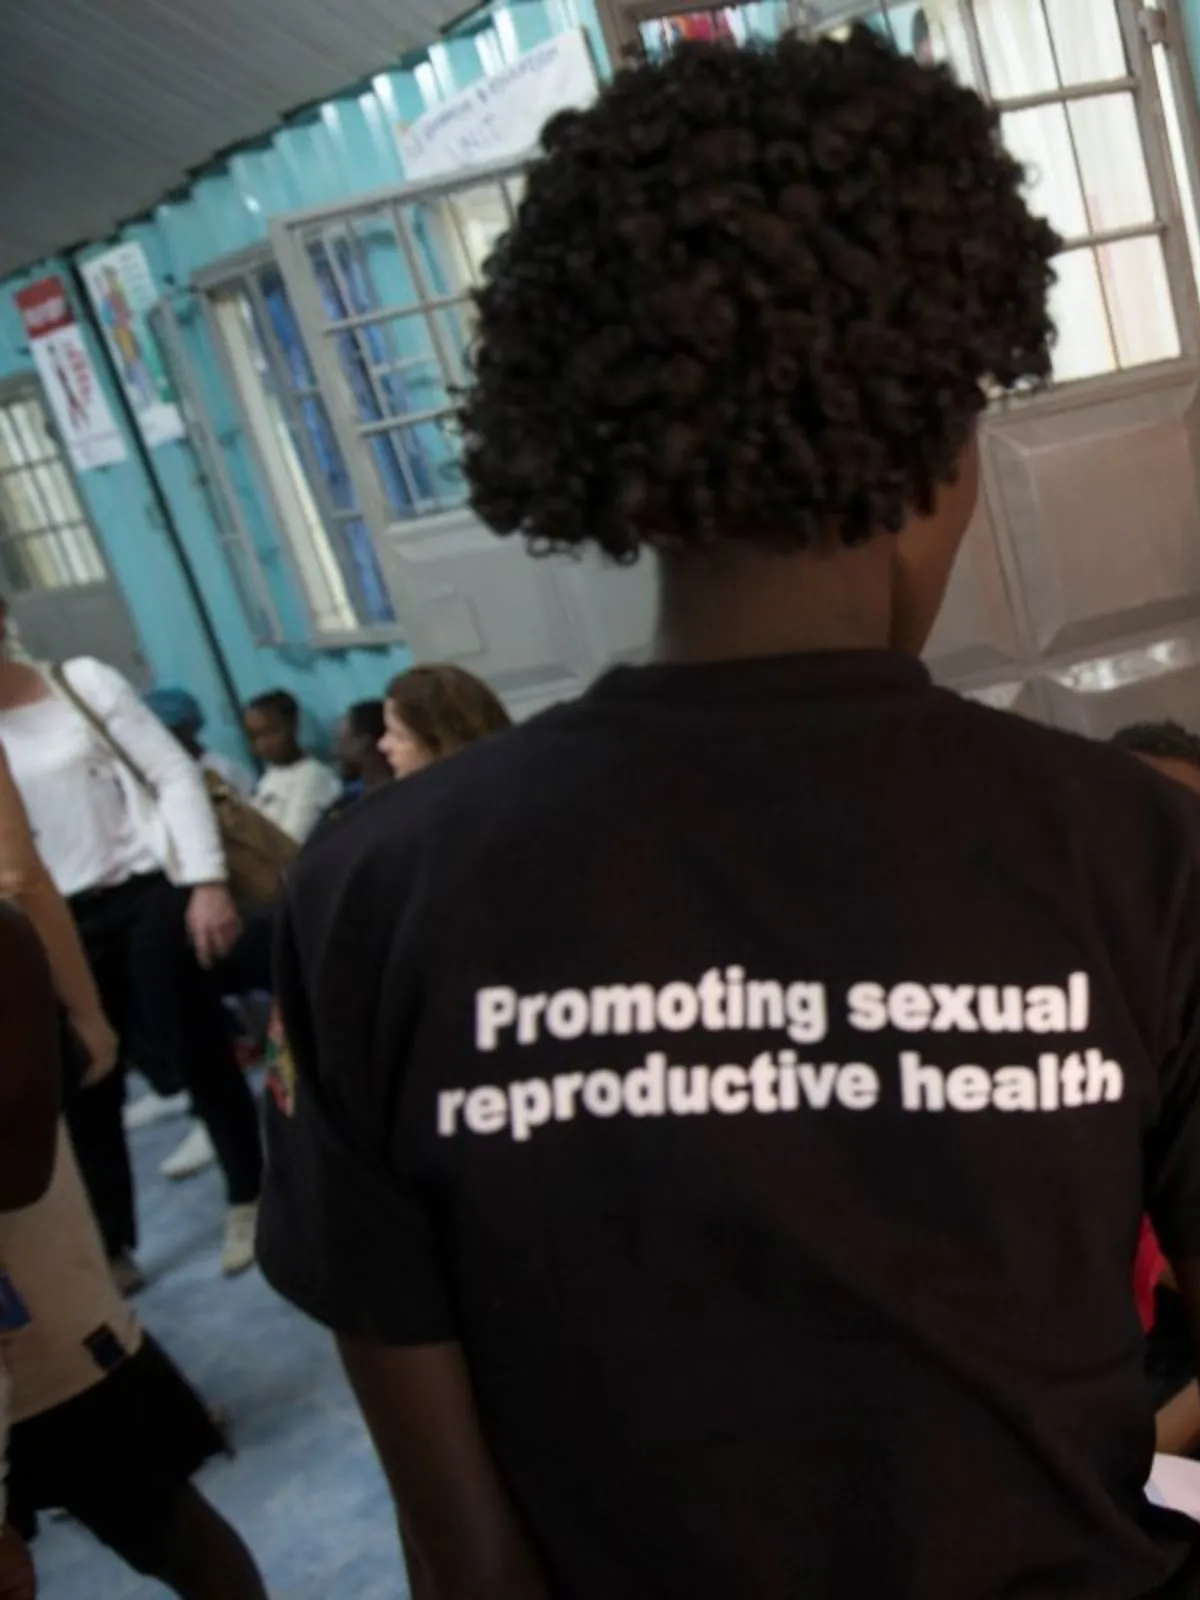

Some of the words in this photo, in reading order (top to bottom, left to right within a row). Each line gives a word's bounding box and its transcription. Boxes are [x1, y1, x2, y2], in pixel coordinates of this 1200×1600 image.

[475, 964, 828, 1052] Promoting
[846, 970, 1090, 1035] sexual
[437, 1048, 881, 1142] reproductive
[898, 1047, 1125, 1113] health
